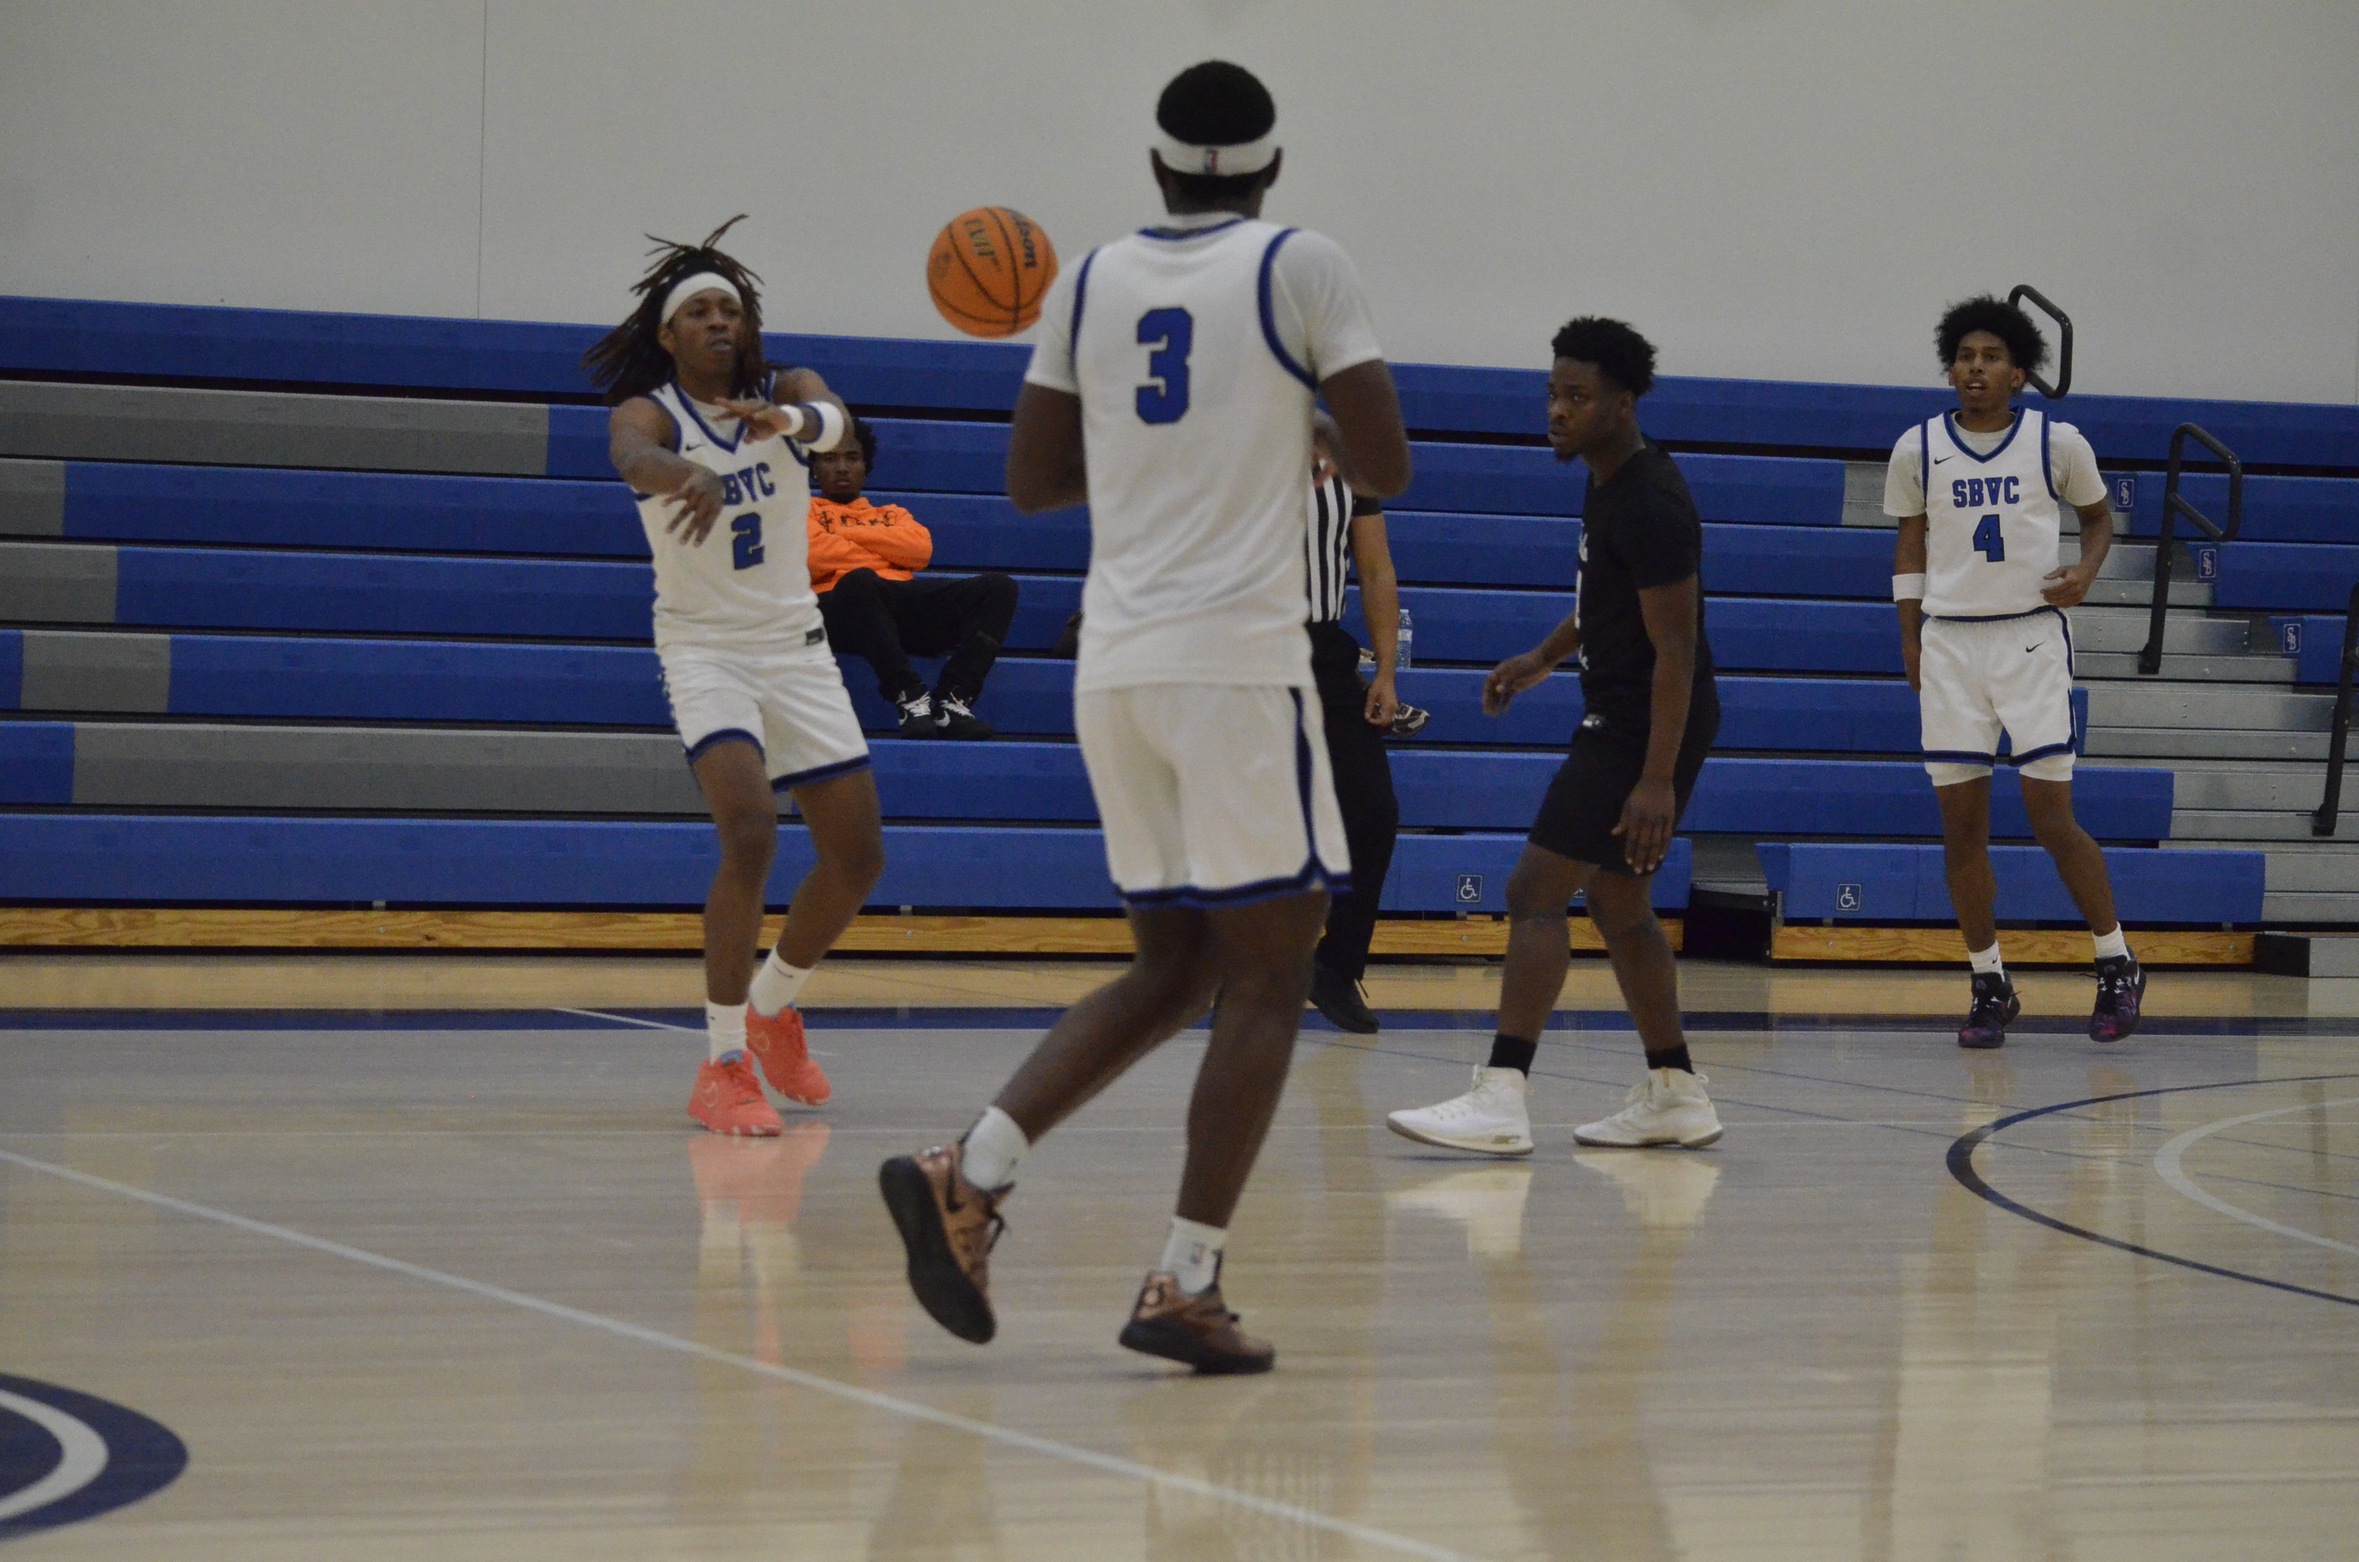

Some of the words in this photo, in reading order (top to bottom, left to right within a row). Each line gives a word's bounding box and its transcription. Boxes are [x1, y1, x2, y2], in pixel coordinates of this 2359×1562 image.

[1135, 307, 1194, 426] 3
[719, 461, 776, 506] BVC
[1952, 475, 2020, 508] SBVC
[731, 512, 765, 570] 2
[1972, 514, 2005, 562] 4
